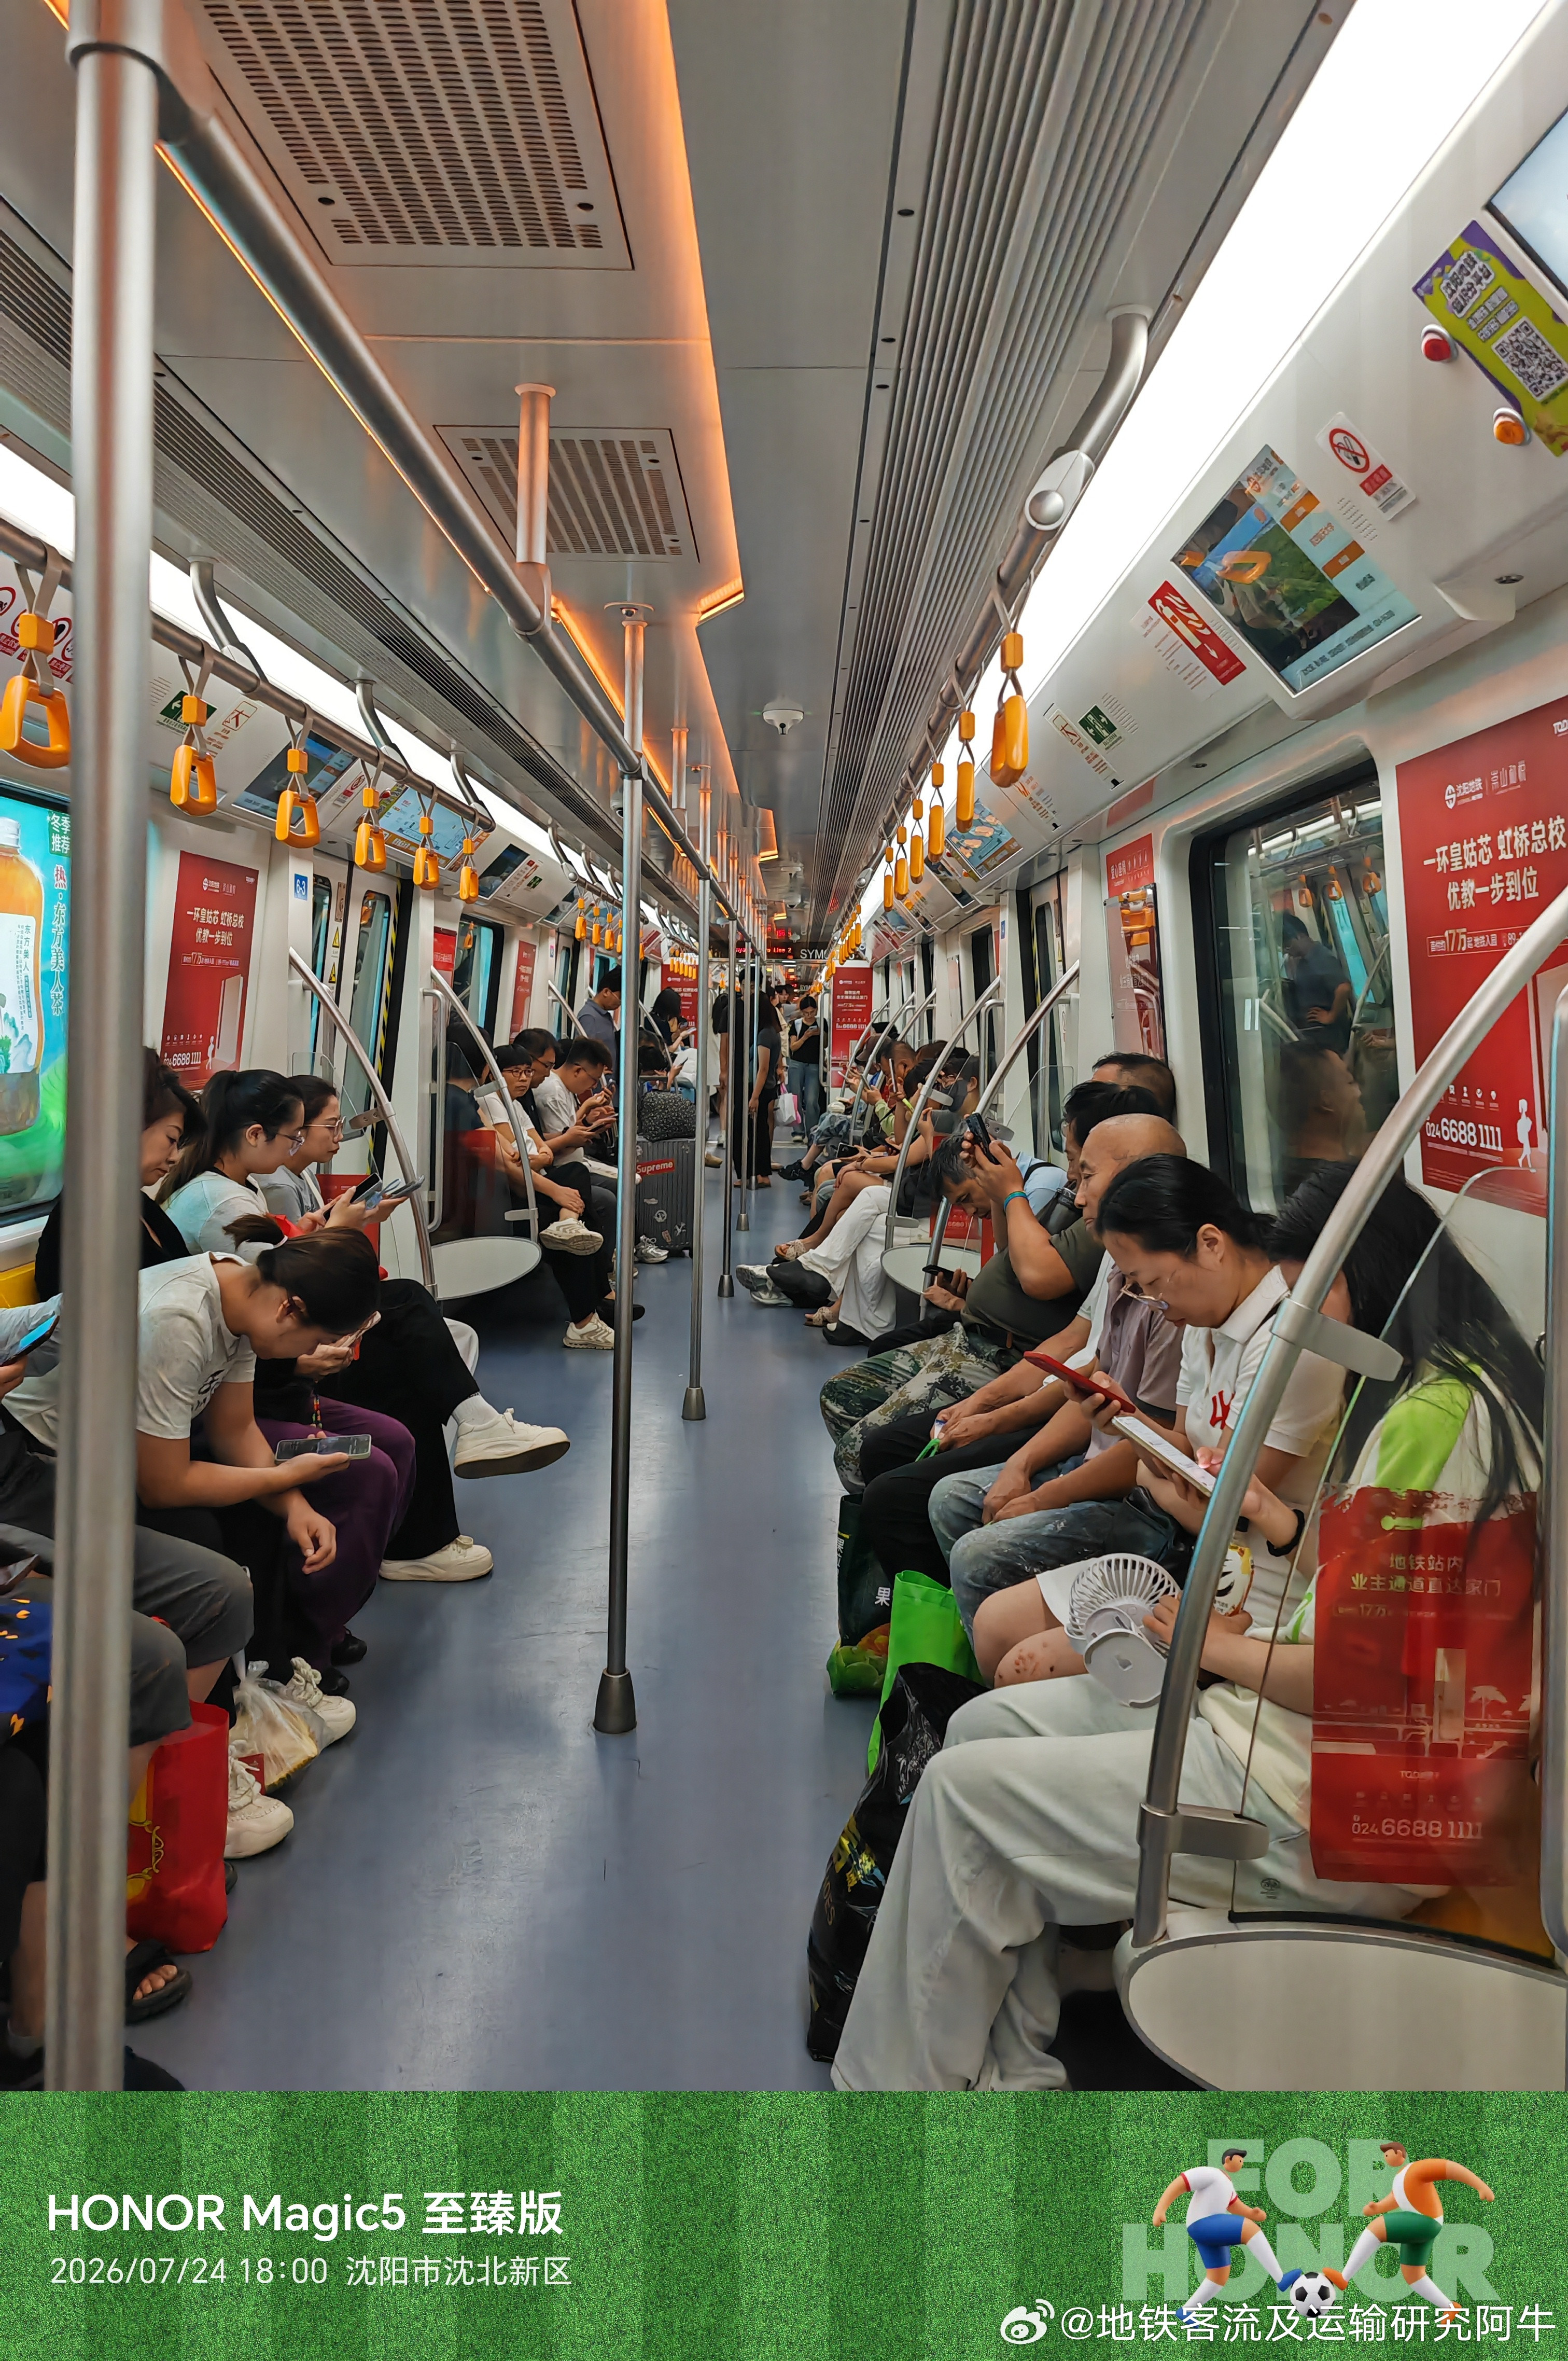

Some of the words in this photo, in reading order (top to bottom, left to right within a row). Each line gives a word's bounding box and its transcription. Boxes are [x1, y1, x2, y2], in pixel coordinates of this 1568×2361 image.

[50, 813, 71, 835] 冬季
[51, 834, 71, 854] 推荐
[1423, 834, 1493, 873] 一环皇姑芯
[1497, 815, 1566, 860] 虹桥总校
[296, 879, 306, 895] 6-3
[1447, 866, 1539, 911] 优教一步到位
[187, 907, 219, 925] 一环皇姑芯
[220, 911, 244, 929] 虹桥总校
[195, 927, 233, 946] 优教一步到位
[23, 925, 31, 971] 东方美人
[636, 1162, 674, 1175] Supreme
[1390, 1553, 1463, 1572] 地铁站内
[1351, 1573, 1501, 1596] 业主通道直达家门
[1381, 1818, 1443, 1838] 6688
[1448, 1821, 1483, 1839] 1111
